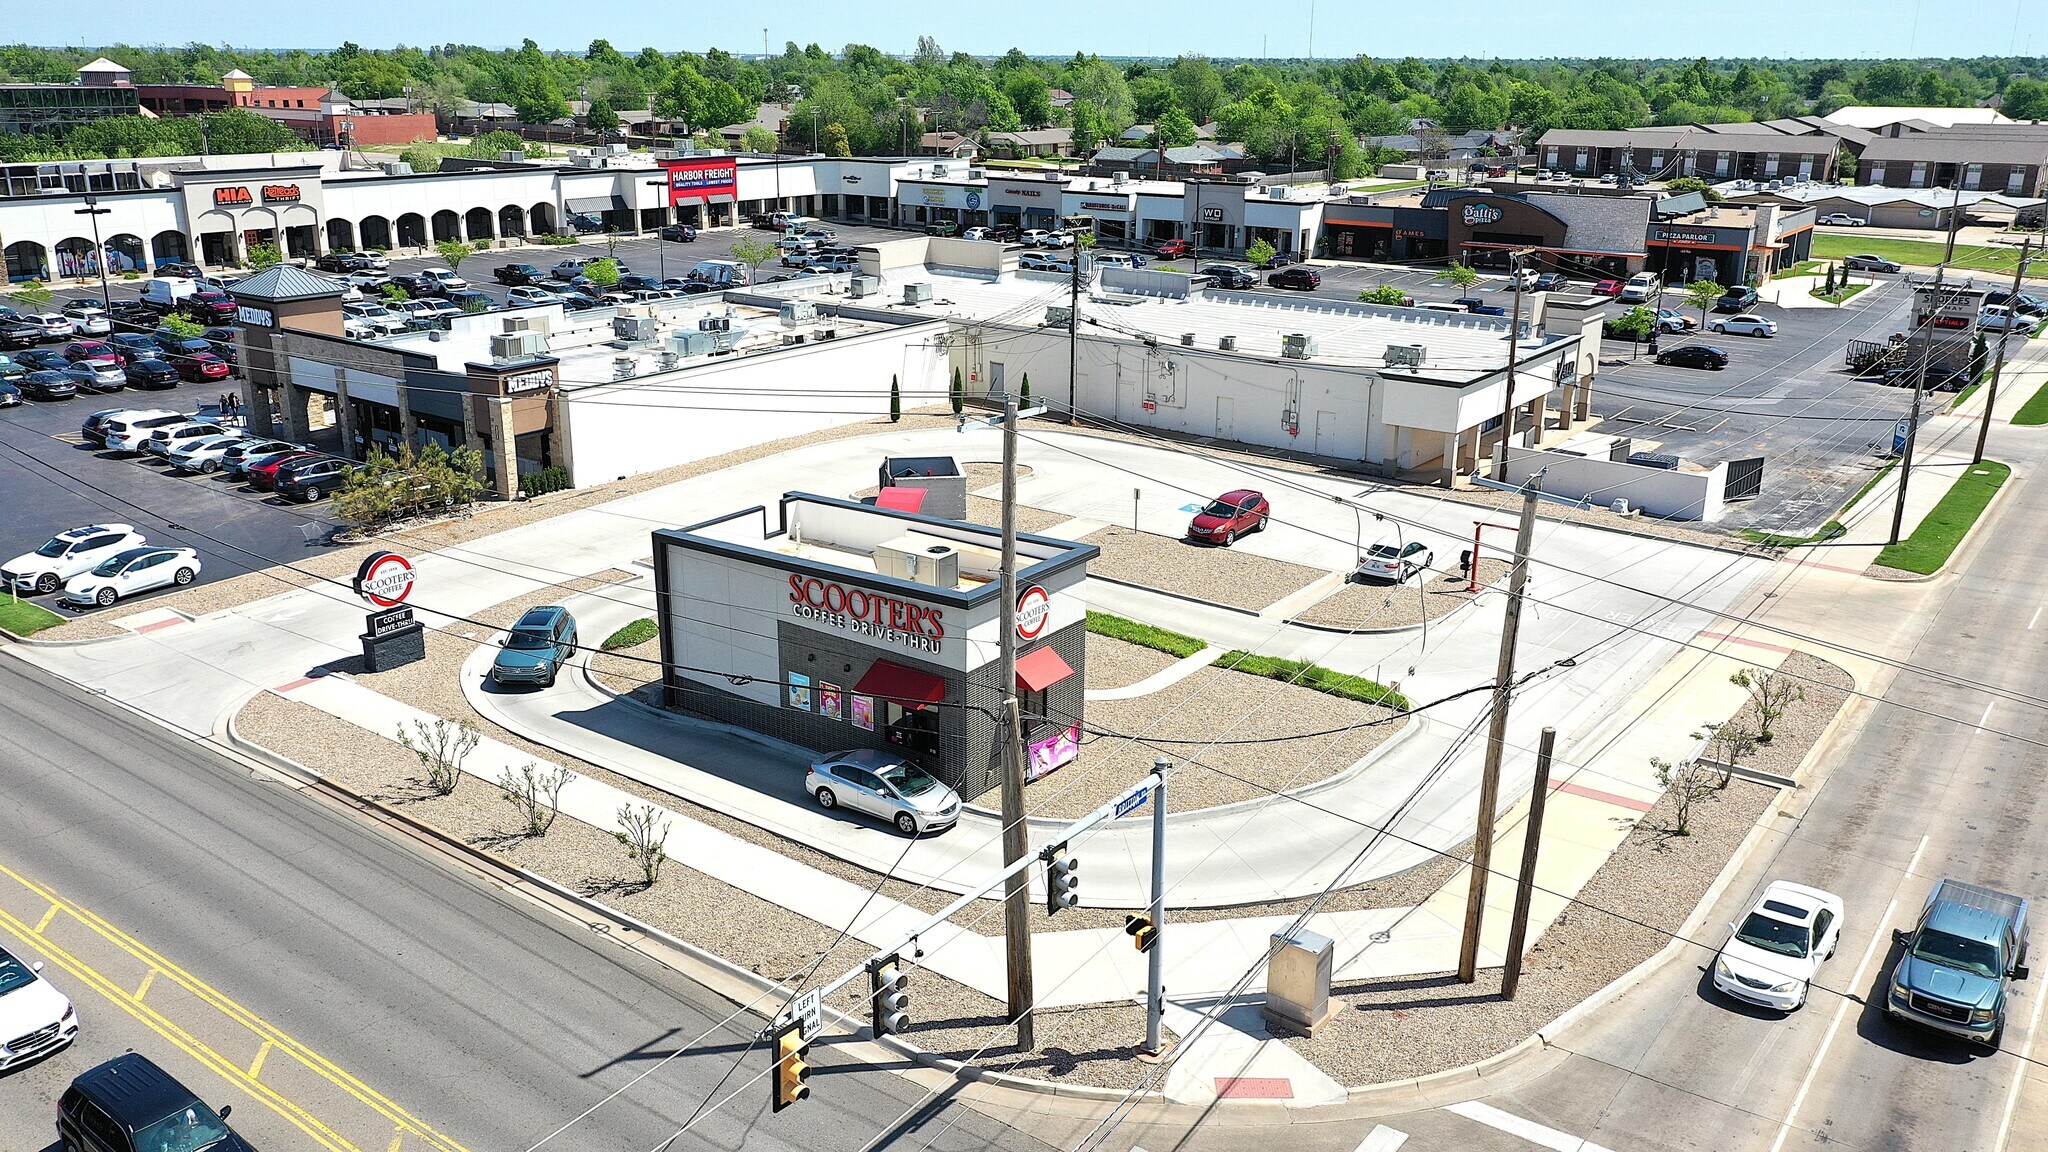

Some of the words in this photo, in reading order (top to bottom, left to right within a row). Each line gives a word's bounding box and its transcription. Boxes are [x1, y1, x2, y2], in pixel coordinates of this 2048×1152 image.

[673, 170, 703, 181] HARBOR
[704, 168, 734, 180] FREIGHT
[216, 188, 251, 201] HIA
[1682, 233, 1708, 241] PARLOR
[1924, 294, 1971, 305] SOPPES
[365, 571, 415, 591] SCOOTER'S
[378, 584, 404, 596] COFFEE
[789, 574, 945, 640] SCOOTER'S
[383, 612, 406, 624] COFFEE
[1024, 615, 1041, 628] COFFEE
[377, 618, 413, 634] DRIVE-THRU
[793, 604, 845, 629] COFFEE
[851, 619, 941, 655] DRIVE-THRU
[798, 994, 814, 1011] LEFT
[1927, 1003, 1953, 1015] GMC
[803, 1019, 820, 1036] GNAL
